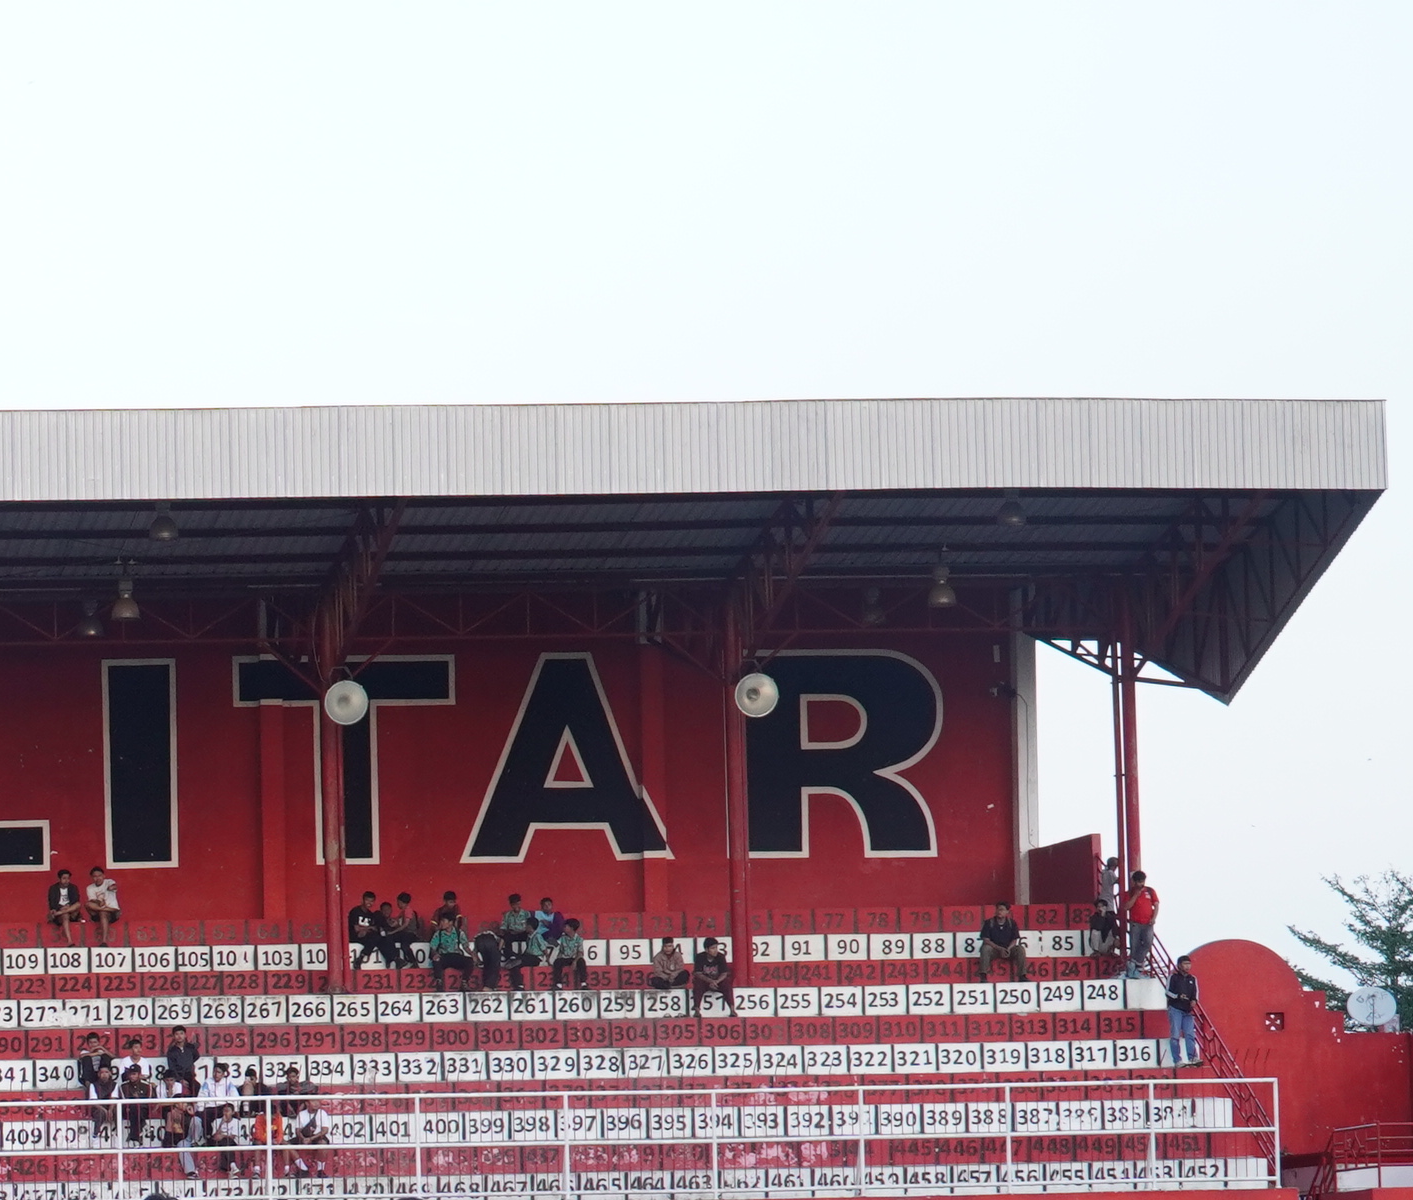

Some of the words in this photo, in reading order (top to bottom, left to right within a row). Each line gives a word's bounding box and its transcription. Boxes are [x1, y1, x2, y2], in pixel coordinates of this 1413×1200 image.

[50, 952, 82, 969] 108
[138, 952, 170, 968] 106
[619, 944, 642, 961] 95
[791, 940, 812, 956] 91
[881, 939, 905, 956] 89
[1052, 935, 1074, 951] 85
[113, 1004, 149, 1021] 270
[203, 1002, 239, 1020] 268
[291, 1001, 326, 1018] 266
[379, 1000, 413, 1017] 264
[735, 994, 770, 1011] 256
[867, 991, 899, 1008] 253
[956, 989, 989, 1006] 251
[1043, 985, 1075, 1002] 249
[309, 1060, 345, 1077] 334
[492, 1056, 528, 1074] 330
[718, 1052, 753, 1069] 325
[807, 1050, 842, 1067] 323
[897, 1049, 933, 1067] 321
[1030, 1047, 1066, 1064] 318
[1118, 1045, 1151, 1062] 316
